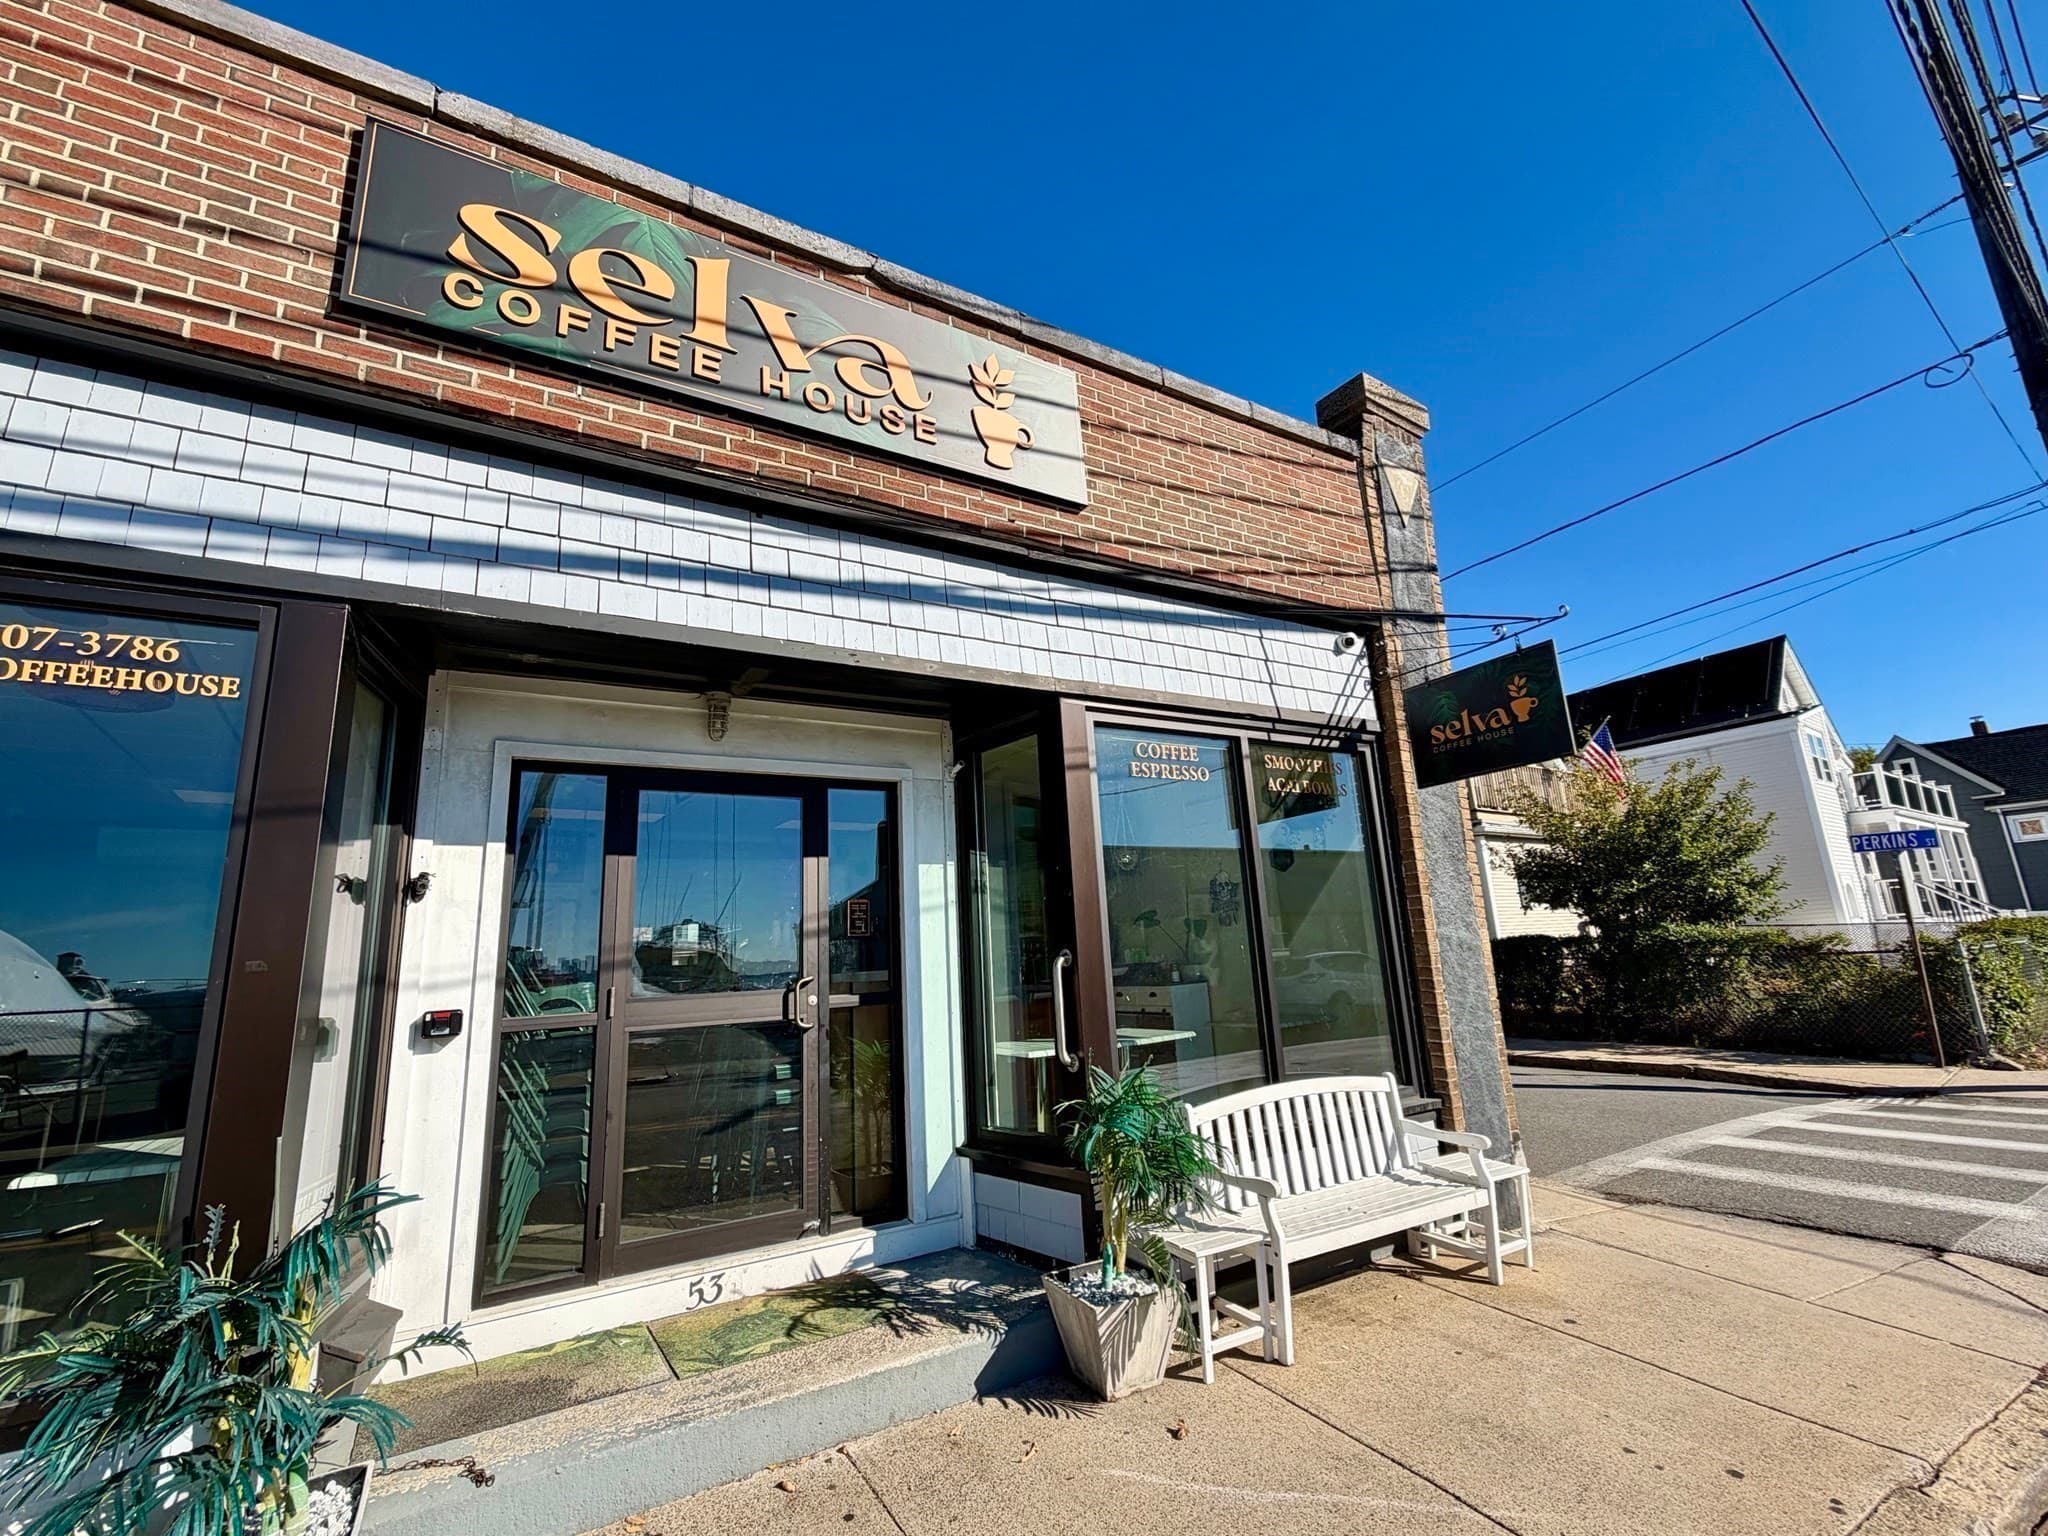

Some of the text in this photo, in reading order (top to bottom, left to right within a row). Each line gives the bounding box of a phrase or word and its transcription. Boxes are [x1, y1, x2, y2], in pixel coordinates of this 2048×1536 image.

[441, 272, 938, 445] COFFEE HOUSE
[1, 624, 180, 663] 07-3786
[0, 657, 241, 698] OFFEEHOUSE
[1430, 708, 1511, 744] selva
[1433, 727, 1515, 754] COFFEE HOUSE
[1136, 742, 1200, 762] COFFEE
[1130, 761, 1210, 782] ESPRESSO
[1851, 832, 1936, 851] PERKINS ST
[685, 1272, 726, 1311] 53
